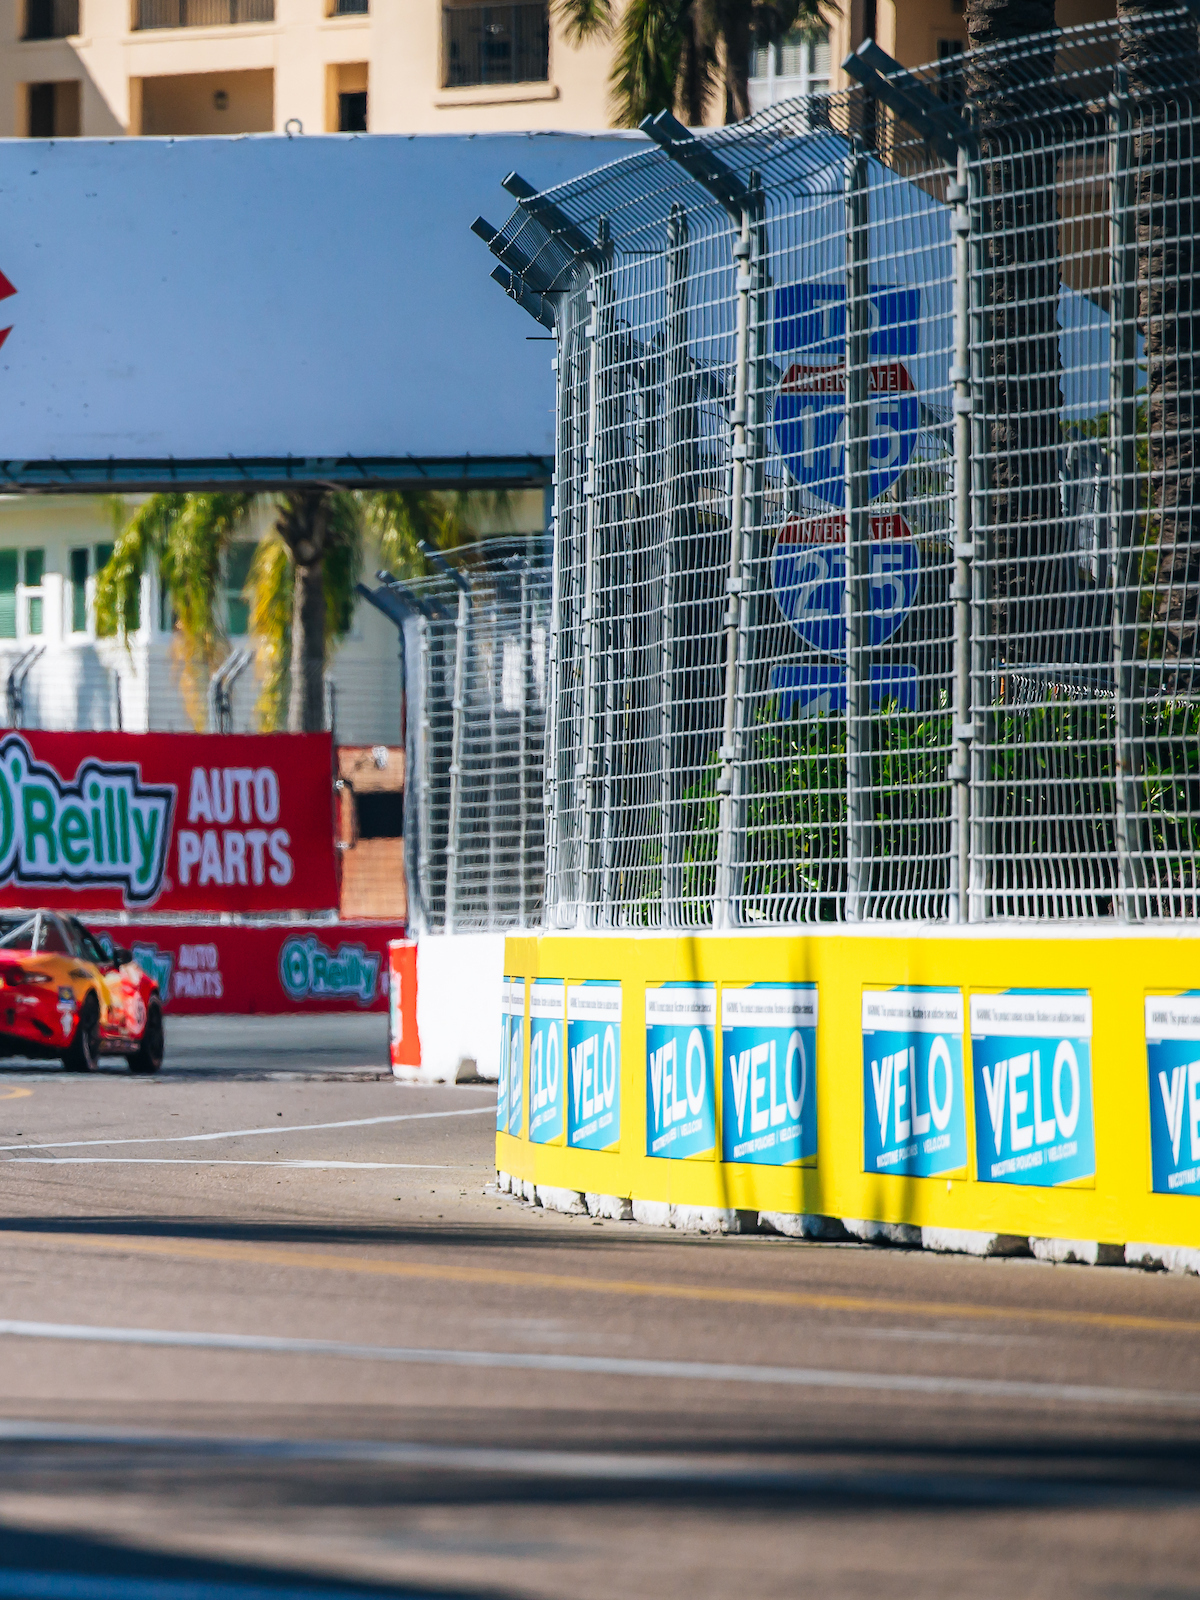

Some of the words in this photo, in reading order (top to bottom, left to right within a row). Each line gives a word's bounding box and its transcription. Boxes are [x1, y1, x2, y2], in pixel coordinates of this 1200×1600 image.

[812, 298, 880, 338] T
[797, 371, 897, 389] INTERATE
[796, 522, 894, 540] INTERATE
[188, 767, 280, 824] AUTO
[177, 828, 294, 886] PARTS
[571, 1024, 616, 1124] VELO
[650, 1028, 707, 1133] VELO
[729, 1030, 807, 1138] VELO
[871, 1035, 953, 1148] VELO
[982, 1039, 1080, 1156] VELO
